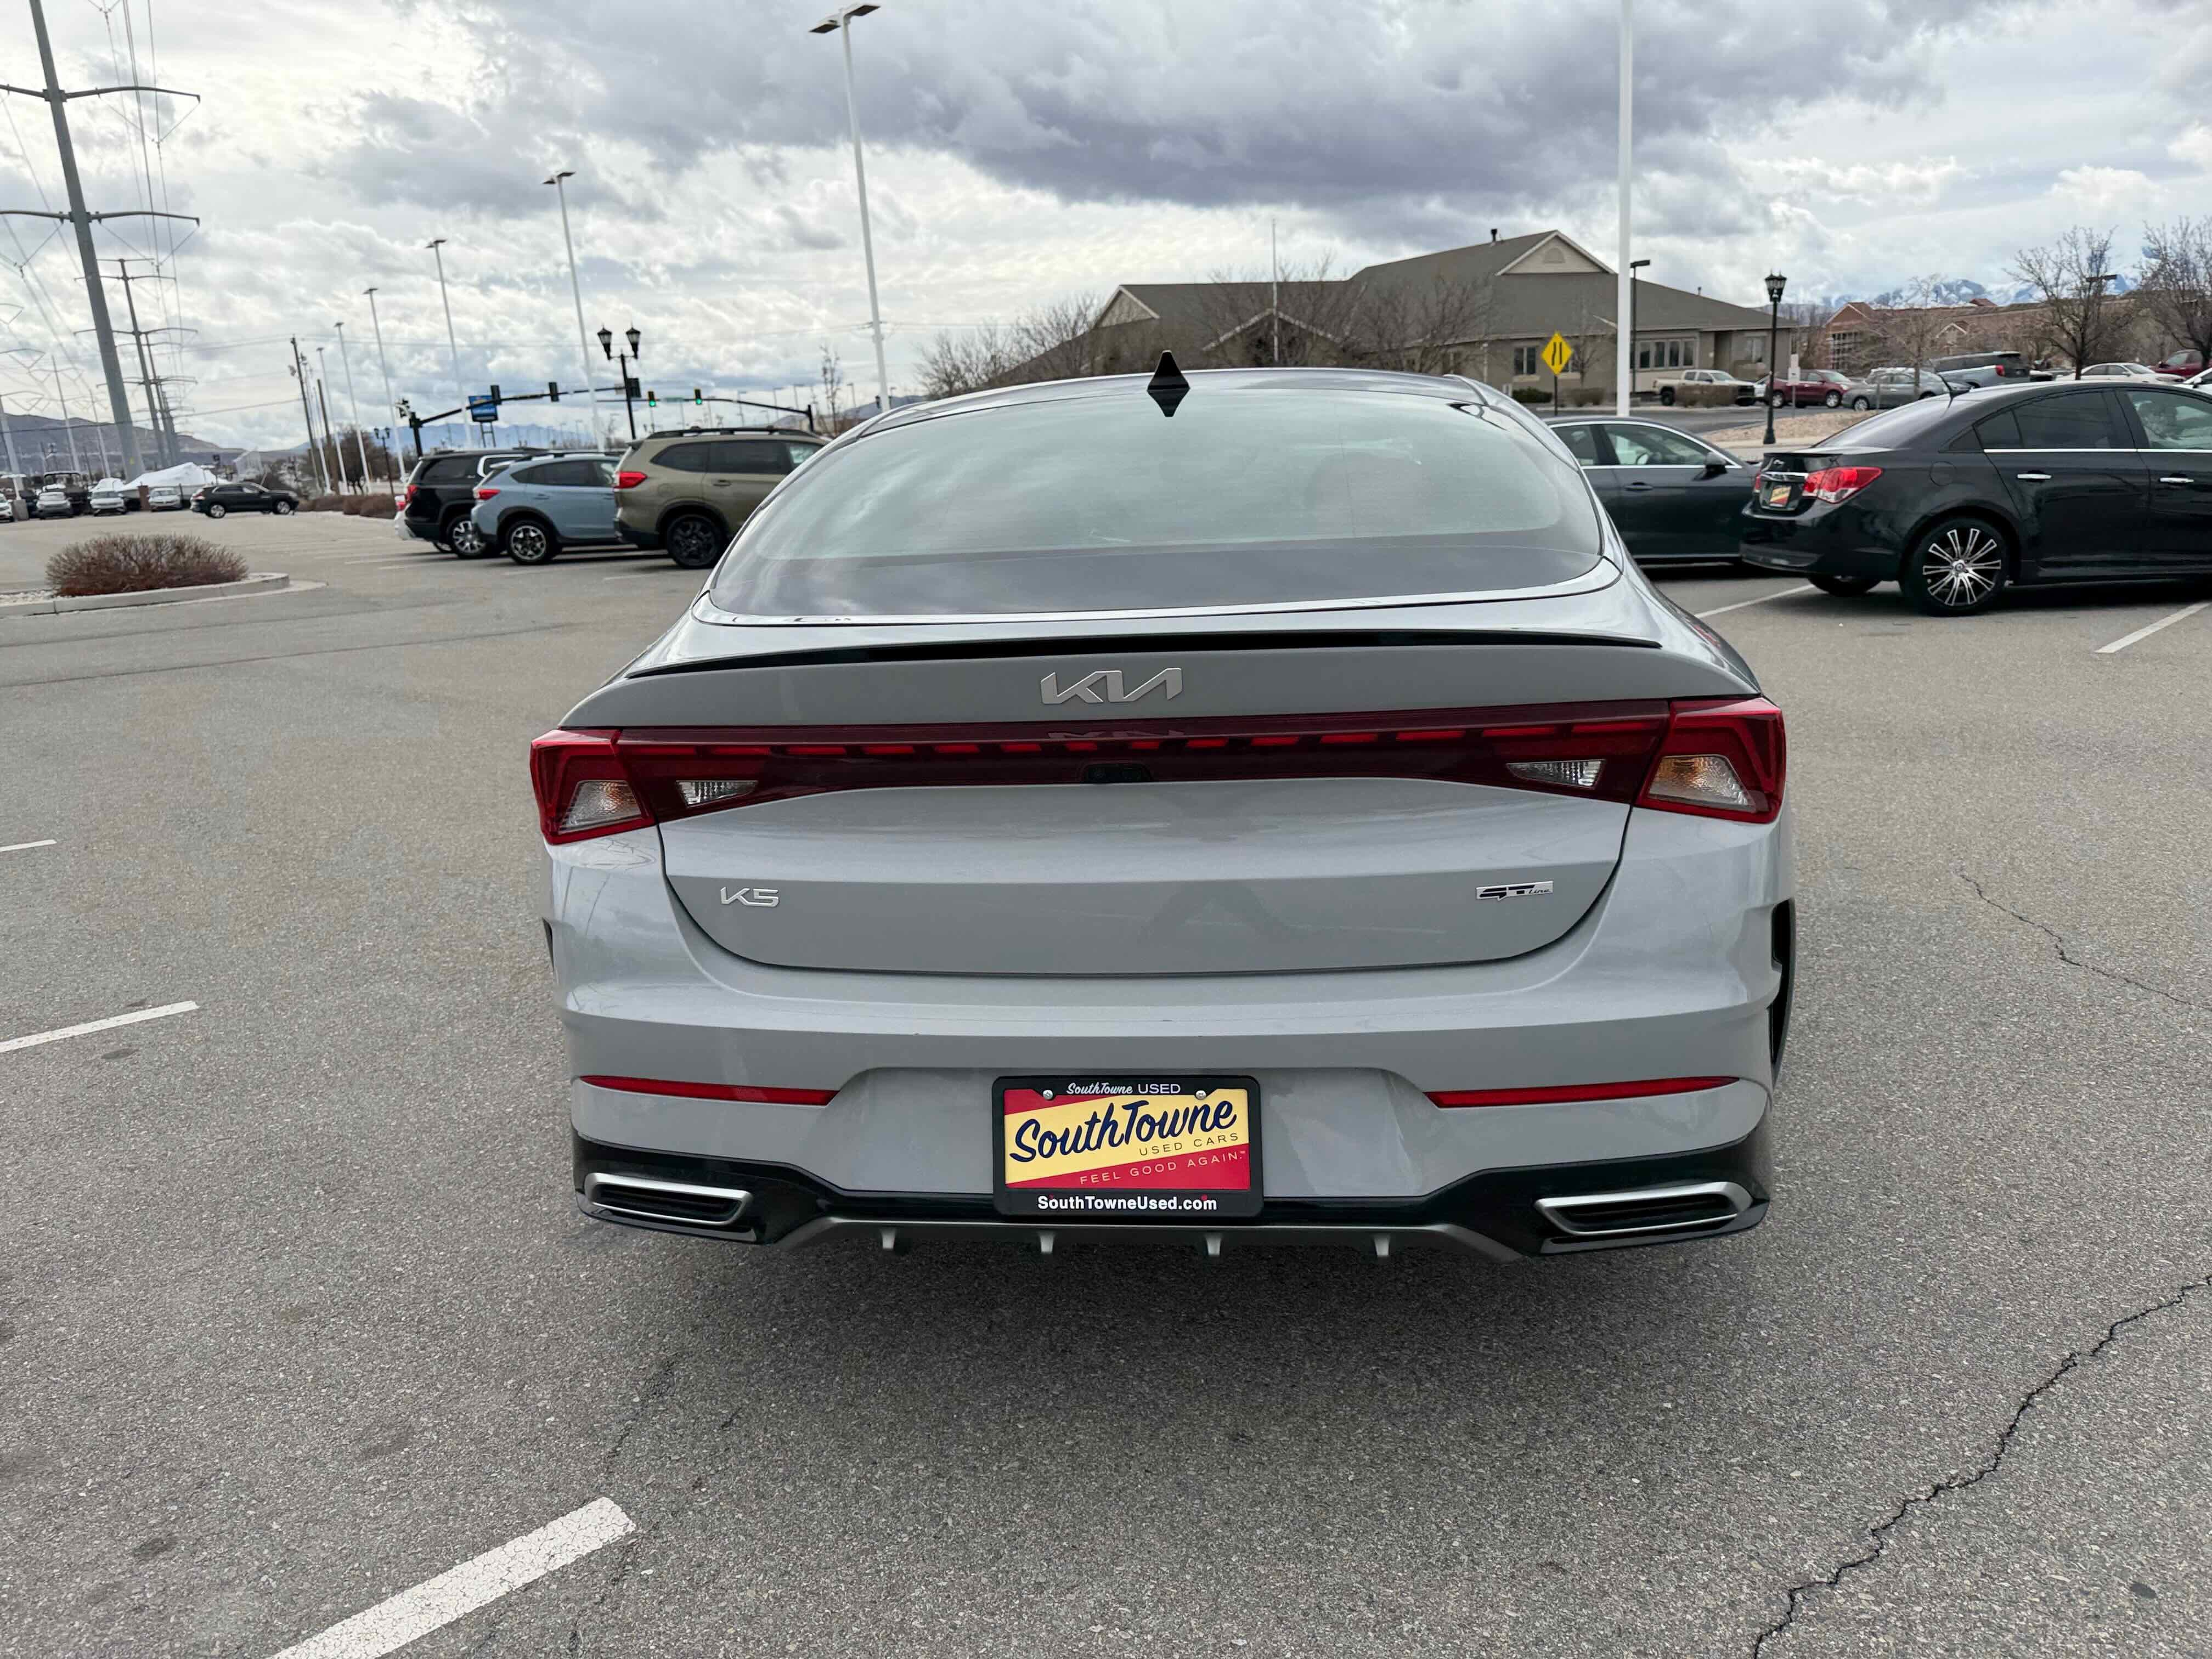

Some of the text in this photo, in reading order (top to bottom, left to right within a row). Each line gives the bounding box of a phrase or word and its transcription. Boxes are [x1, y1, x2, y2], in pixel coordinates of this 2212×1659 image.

[1041, 668, 1183, 704] KIA
[720, 887, 778, 907] K5
[1066, 1082, 1181, 1094] SouthTowne USED
[1009, 1100, 1237, 1163] SouthTowne
[1139, 1132, 1239, 1156] USED CARS
[1080, 1171, 1121, 1184] FEEL
[1130, 1162, 1177, 1176] GOOD
[1037, 1195, 1217, 1210] SouthTowneUsed.com
